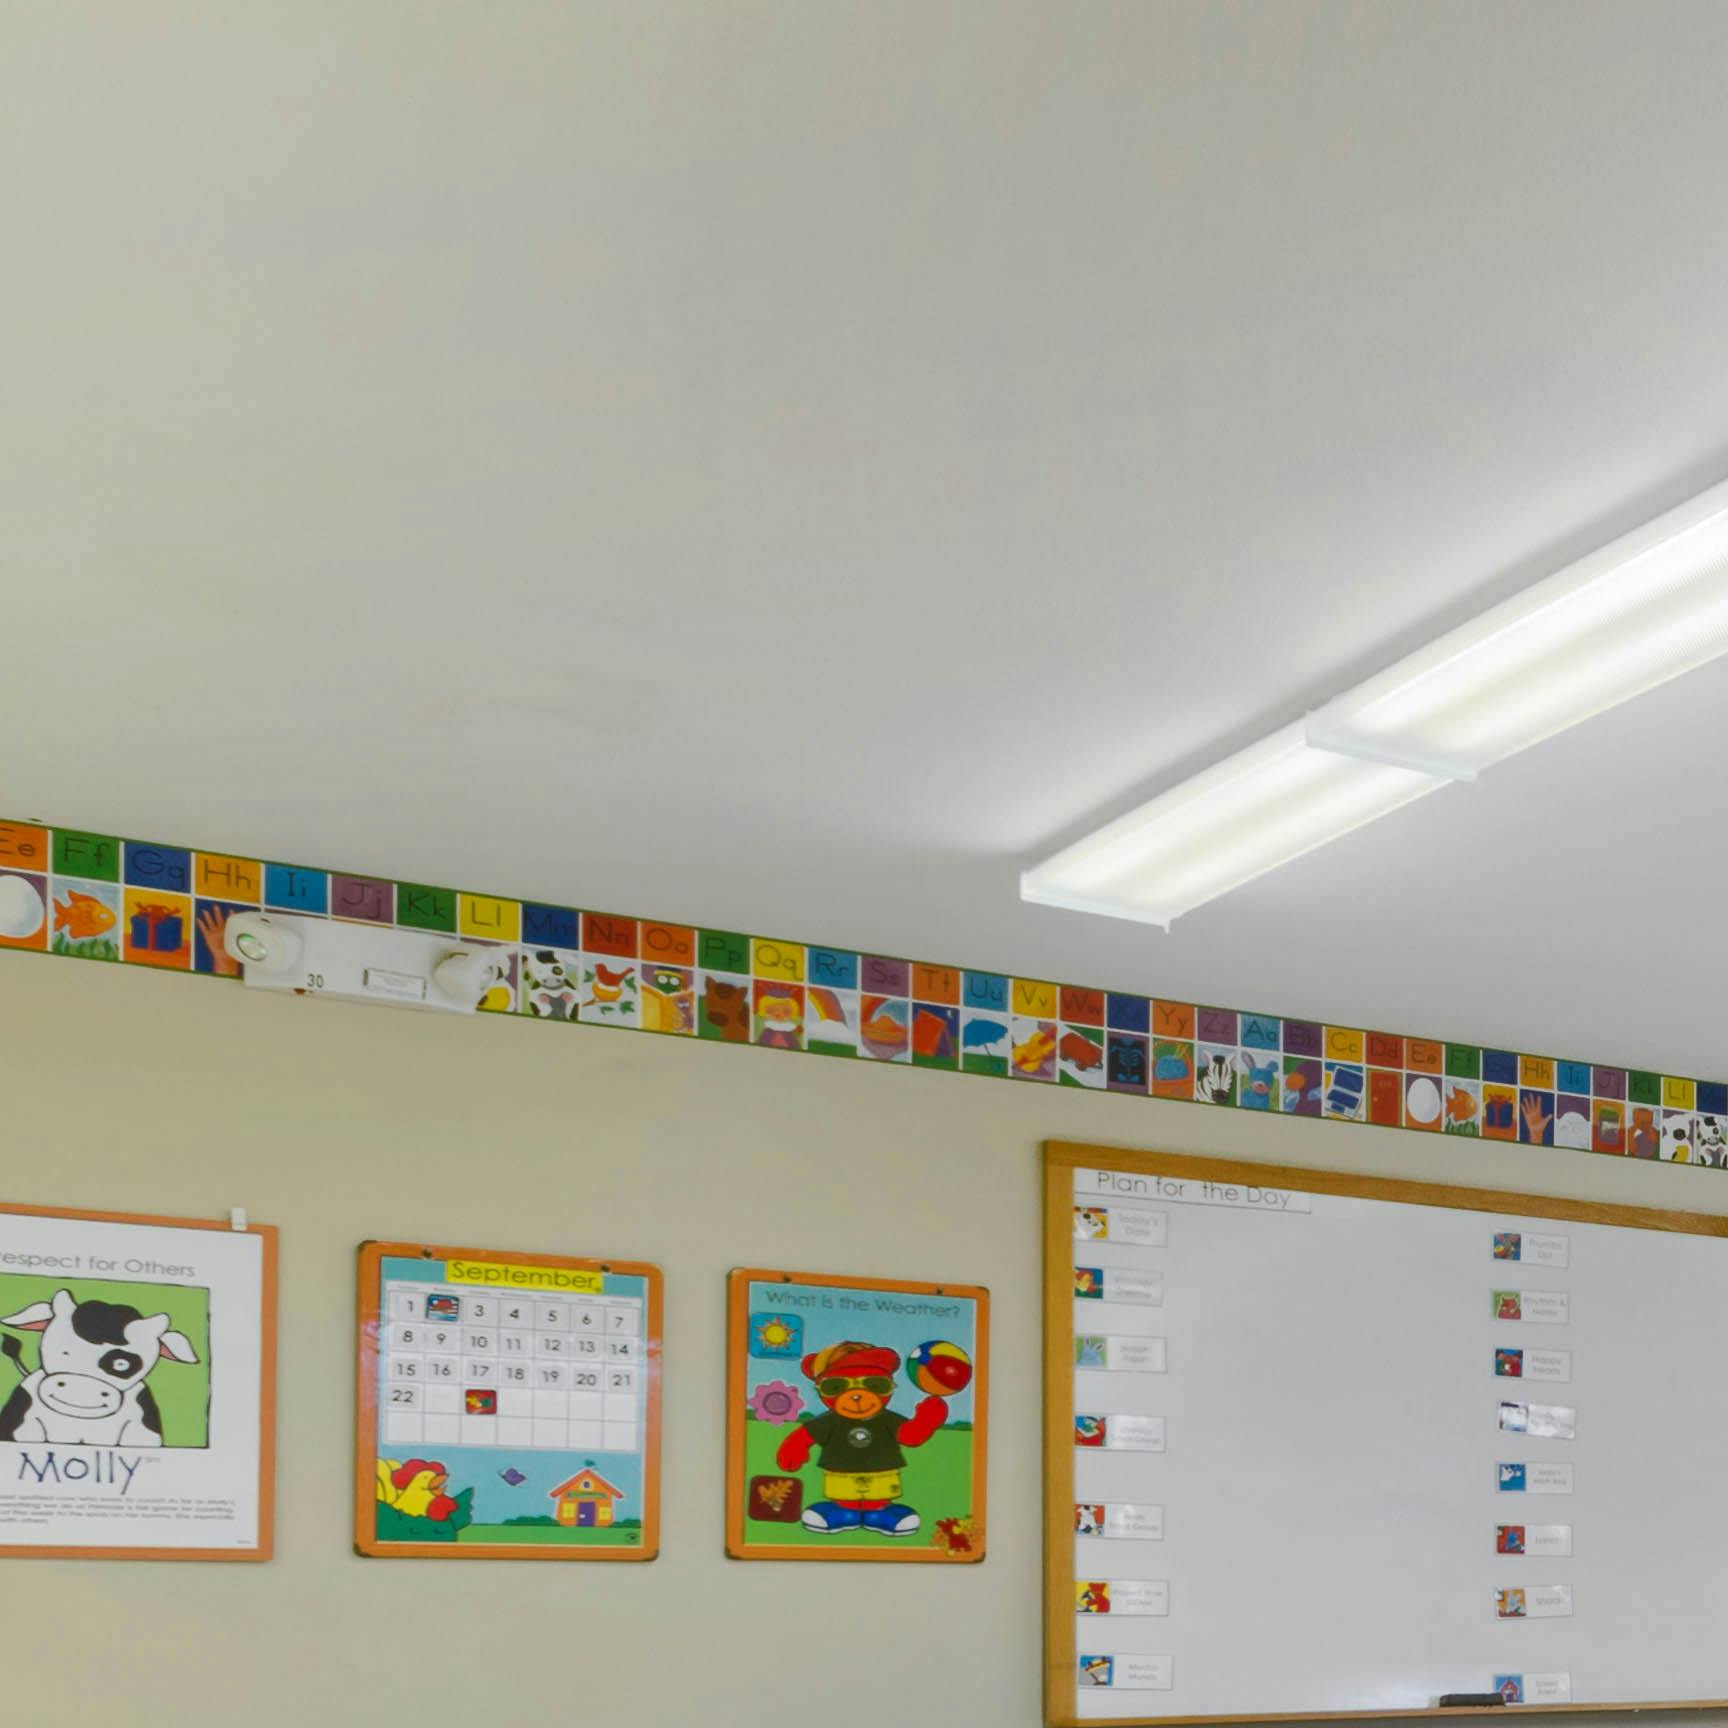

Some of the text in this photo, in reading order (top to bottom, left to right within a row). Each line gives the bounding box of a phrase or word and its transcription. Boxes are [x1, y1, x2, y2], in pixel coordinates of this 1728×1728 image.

[64, 836, 106, 866] Ff
[130, 847, 185, 891] Gg
[203, 859, 254, 891] Hh
[286, 871, 308, 898] Ii
[342, 882, 384, 920] Jj
[406, 892, 448, 921] Kk
[525, 908, 573, 940] Mm
[590, 918, 630, 946] Nn
[646, 927, 690, 955] Oo
[704, 935, 743, 972] Pp
[755, 944, 803, 982] Qq
[814, 952, 849, 977] Rr
[870, 963, 898, 988] Ss
[923, 968, 951, 994] Tt
[970, 975, 1005, 1002] Uu
[1020, 983, 1049, 1008] Vv
[1064, 992, 1103, 1017] Ww
[1158, 1005, 1188, 1033] Yy
[1244, 1019, 1277, 1044] Aa
[1330, 1031, 1358, 1054] Cc
[1370, 1037, 1400, 1060] Dd
[1410, 1044, 1438, 1065] Ee
[1524, 1059, 1551, 1081] Hh
[306, 972, 325, 989] 30
[1096, 1171, 1293, 1208] Plan for the Day
[0, 1251, 197, 1278] espect for Others
[451, 1260, 596, 1289] September
[407, 1300, 624, 1329] 1 3 4 5 6 7
[765, 1290, 961, 1318] What is the Weather?
[402, 1330, 629, 1355] 8 9 10 11 12 13 14
[396, 1362, 631, 1386] 15 16 17 18 19 20 21
[392, 1390, 414, 1403] 22
[18, 1451, 142, 1496] Molly
